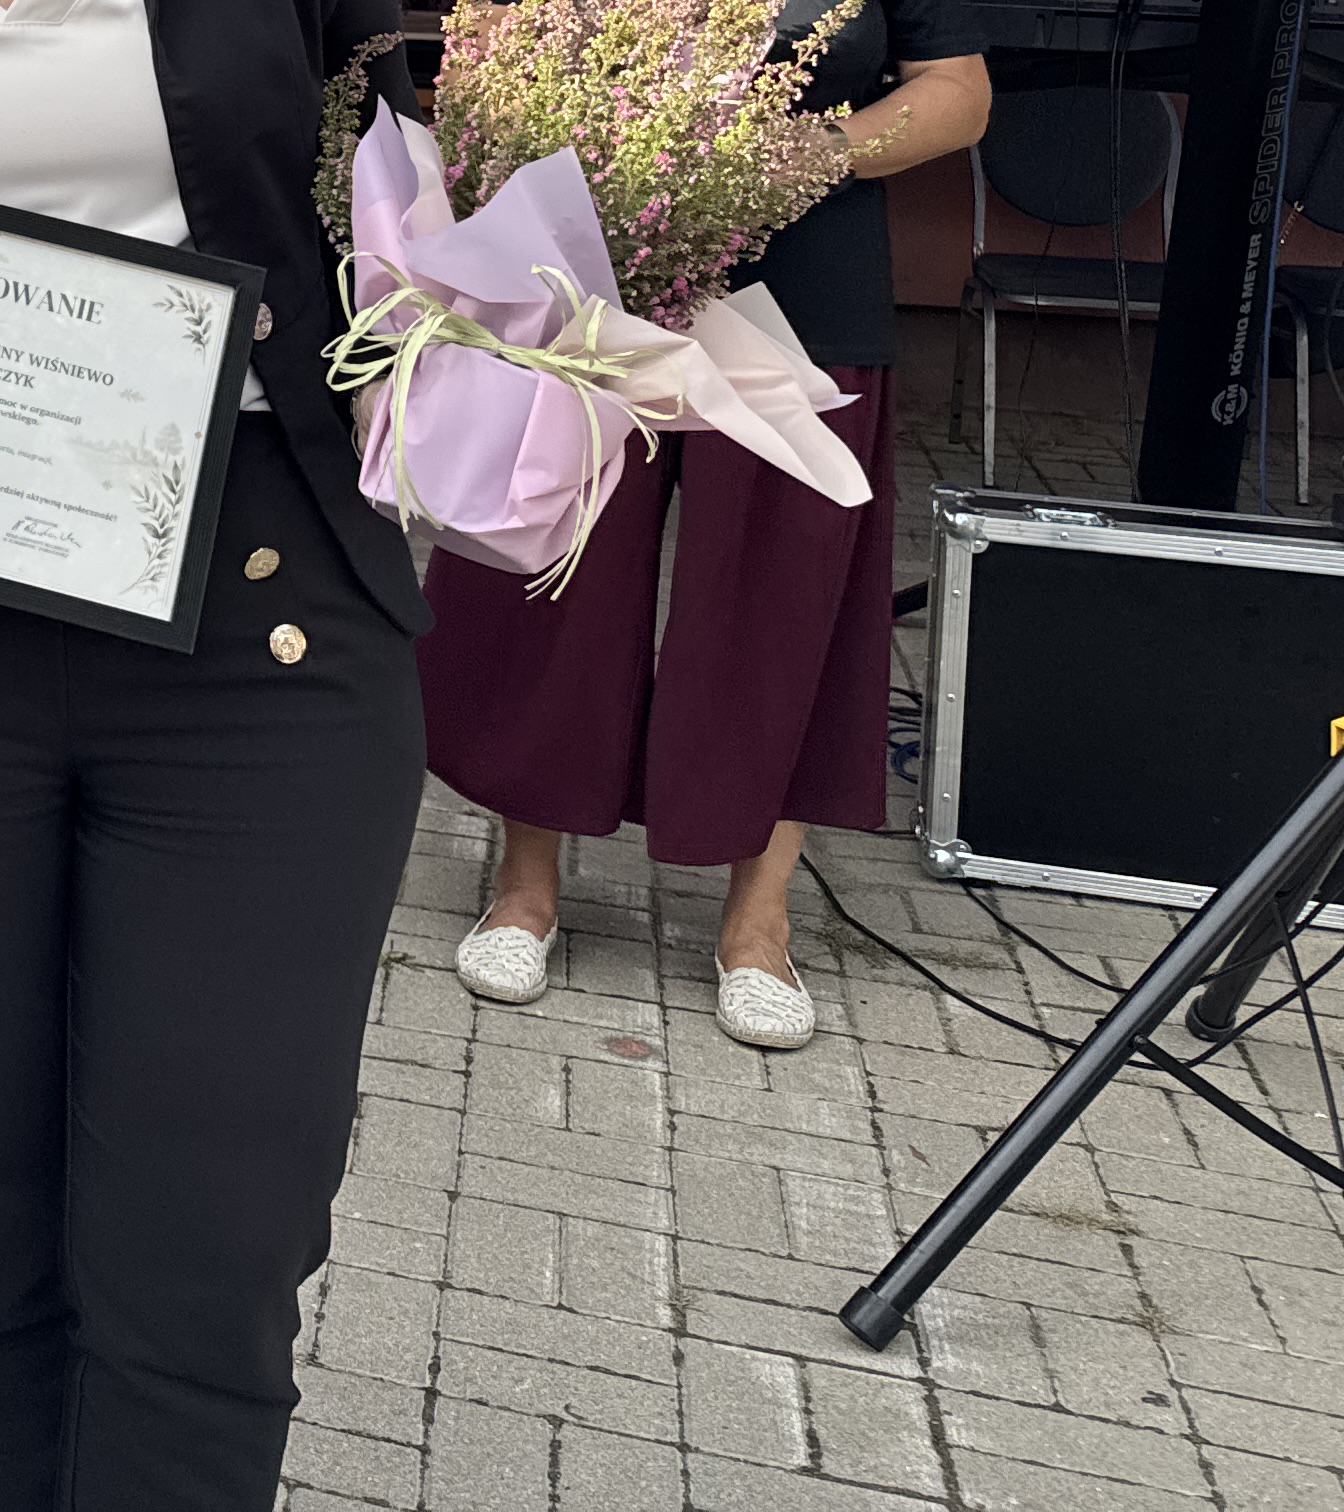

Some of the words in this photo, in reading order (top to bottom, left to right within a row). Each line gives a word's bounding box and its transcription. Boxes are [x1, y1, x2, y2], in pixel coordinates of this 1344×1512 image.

[1242, 233, 1262, 297] MEYER
[1240, 300, 1252, 314] &
[1229, 317, 1249, 376] KÖNIG
[29, 354, 114, 386] WIŚNIEWO
[19, 403, 29, 411] w
[29, 406, 82, 425] organizacji
[1222, 384, 1239, 426] K&M
